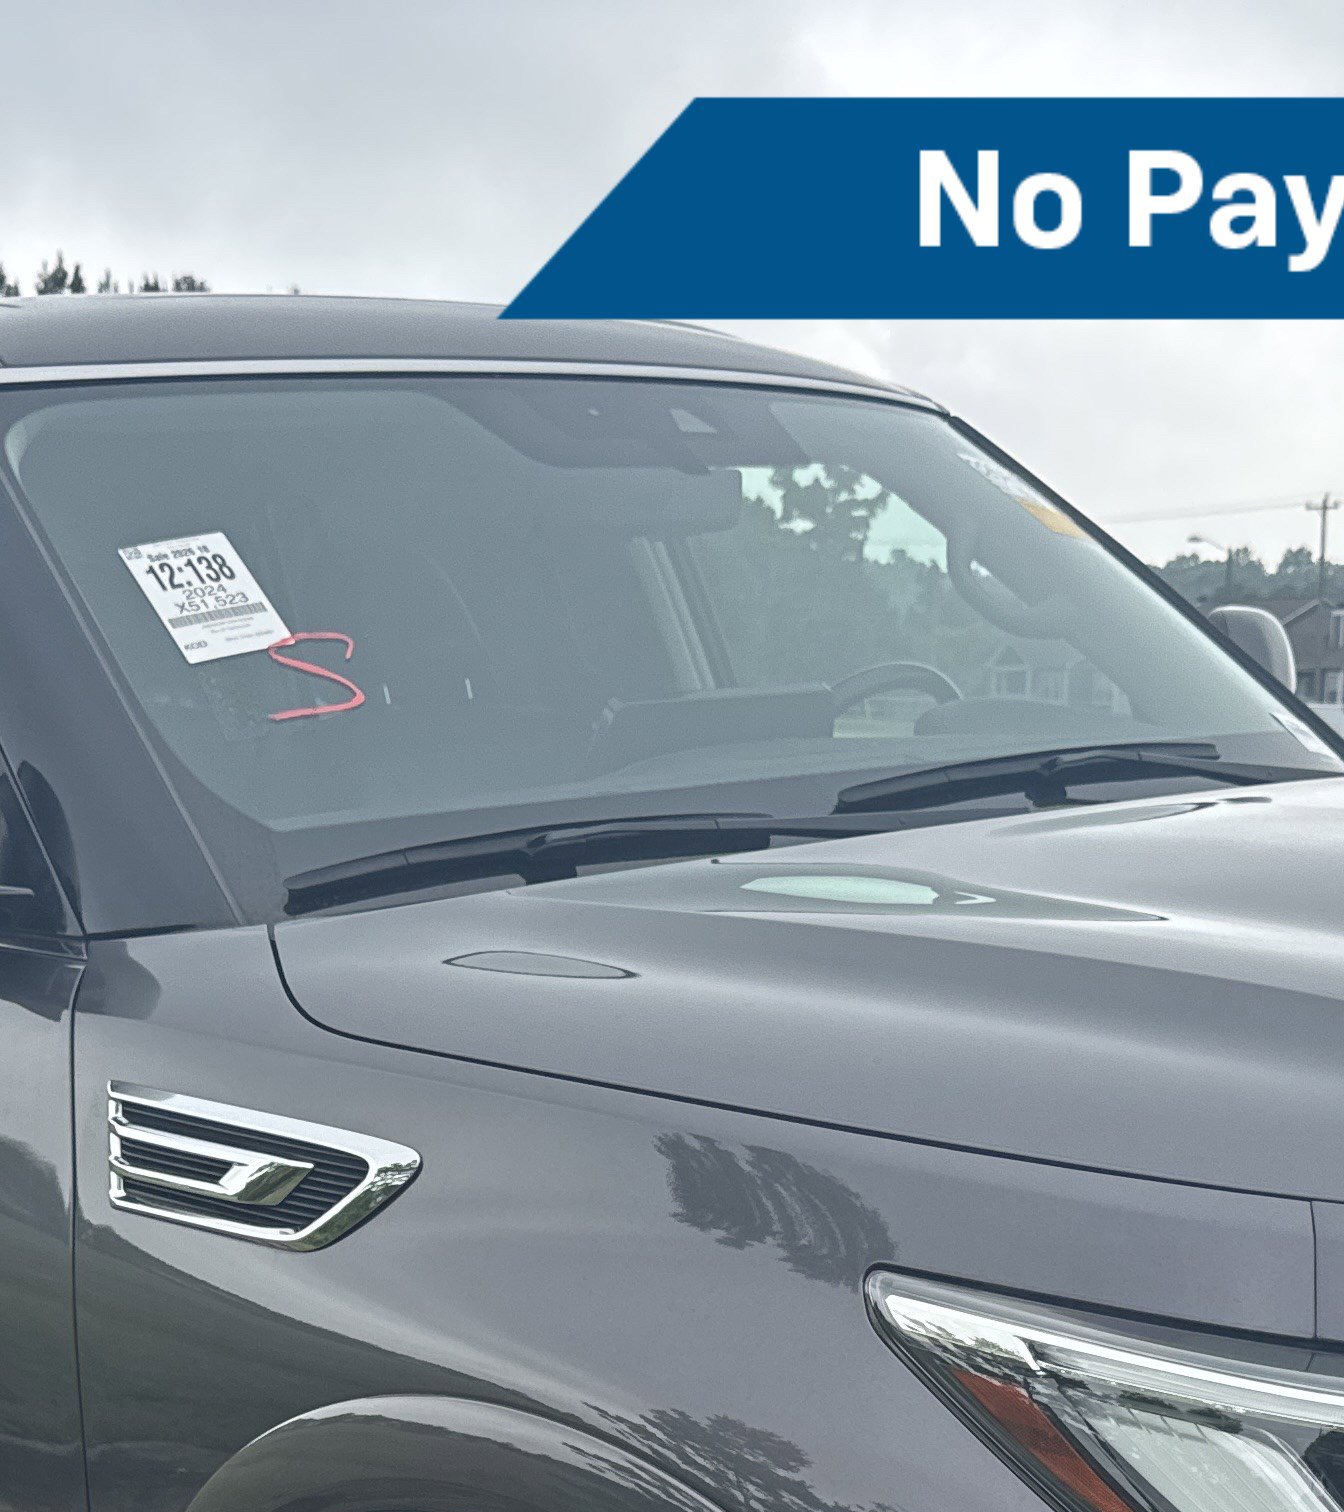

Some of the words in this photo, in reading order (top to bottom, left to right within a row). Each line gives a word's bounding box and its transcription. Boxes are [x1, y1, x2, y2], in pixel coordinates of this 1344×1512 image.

[145, 553, 236, 592] 12:138
[174, 592, 250, 614] X51,523
[182, 583, 228, 601] 2024
